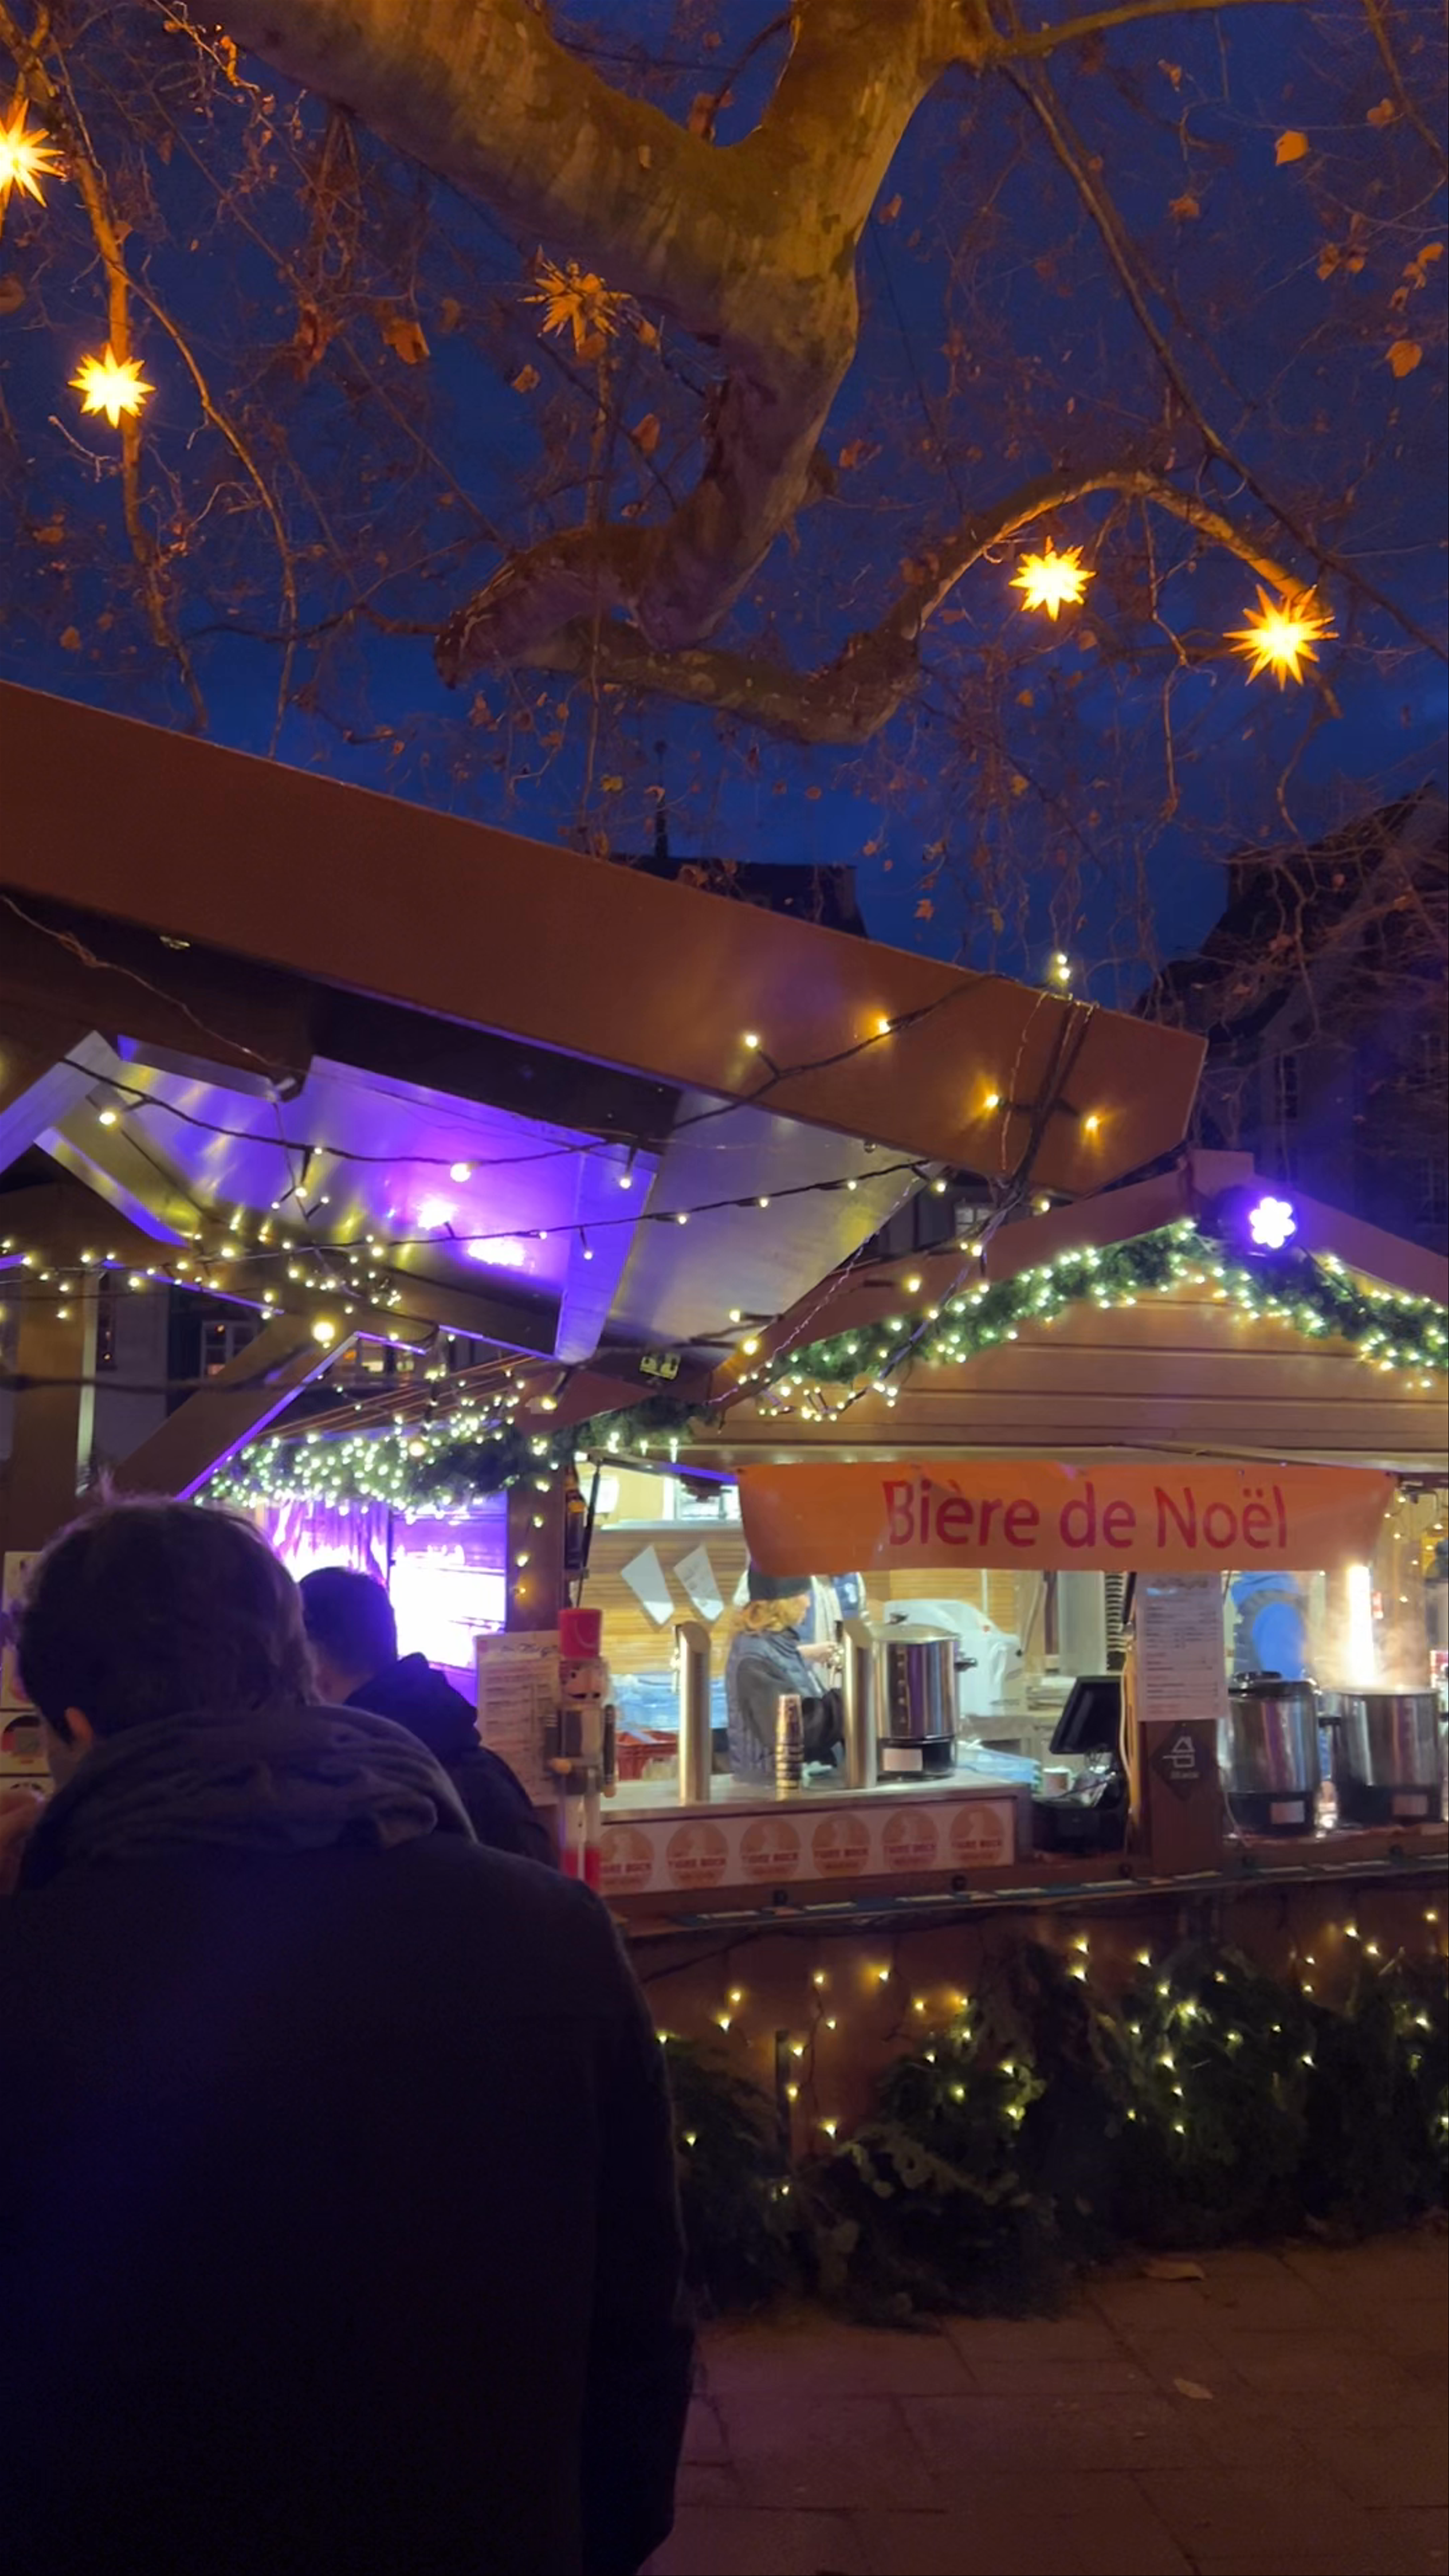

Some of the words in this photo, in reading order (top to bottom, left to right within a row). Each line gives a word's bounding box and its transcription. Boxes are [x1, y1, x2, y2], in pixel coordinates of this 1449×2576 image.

[882, 1479, 1040, 1547] Bière
[1060, 1481, 1136, 1547] de
[1154, 1485, 1287, 1549] Noël
